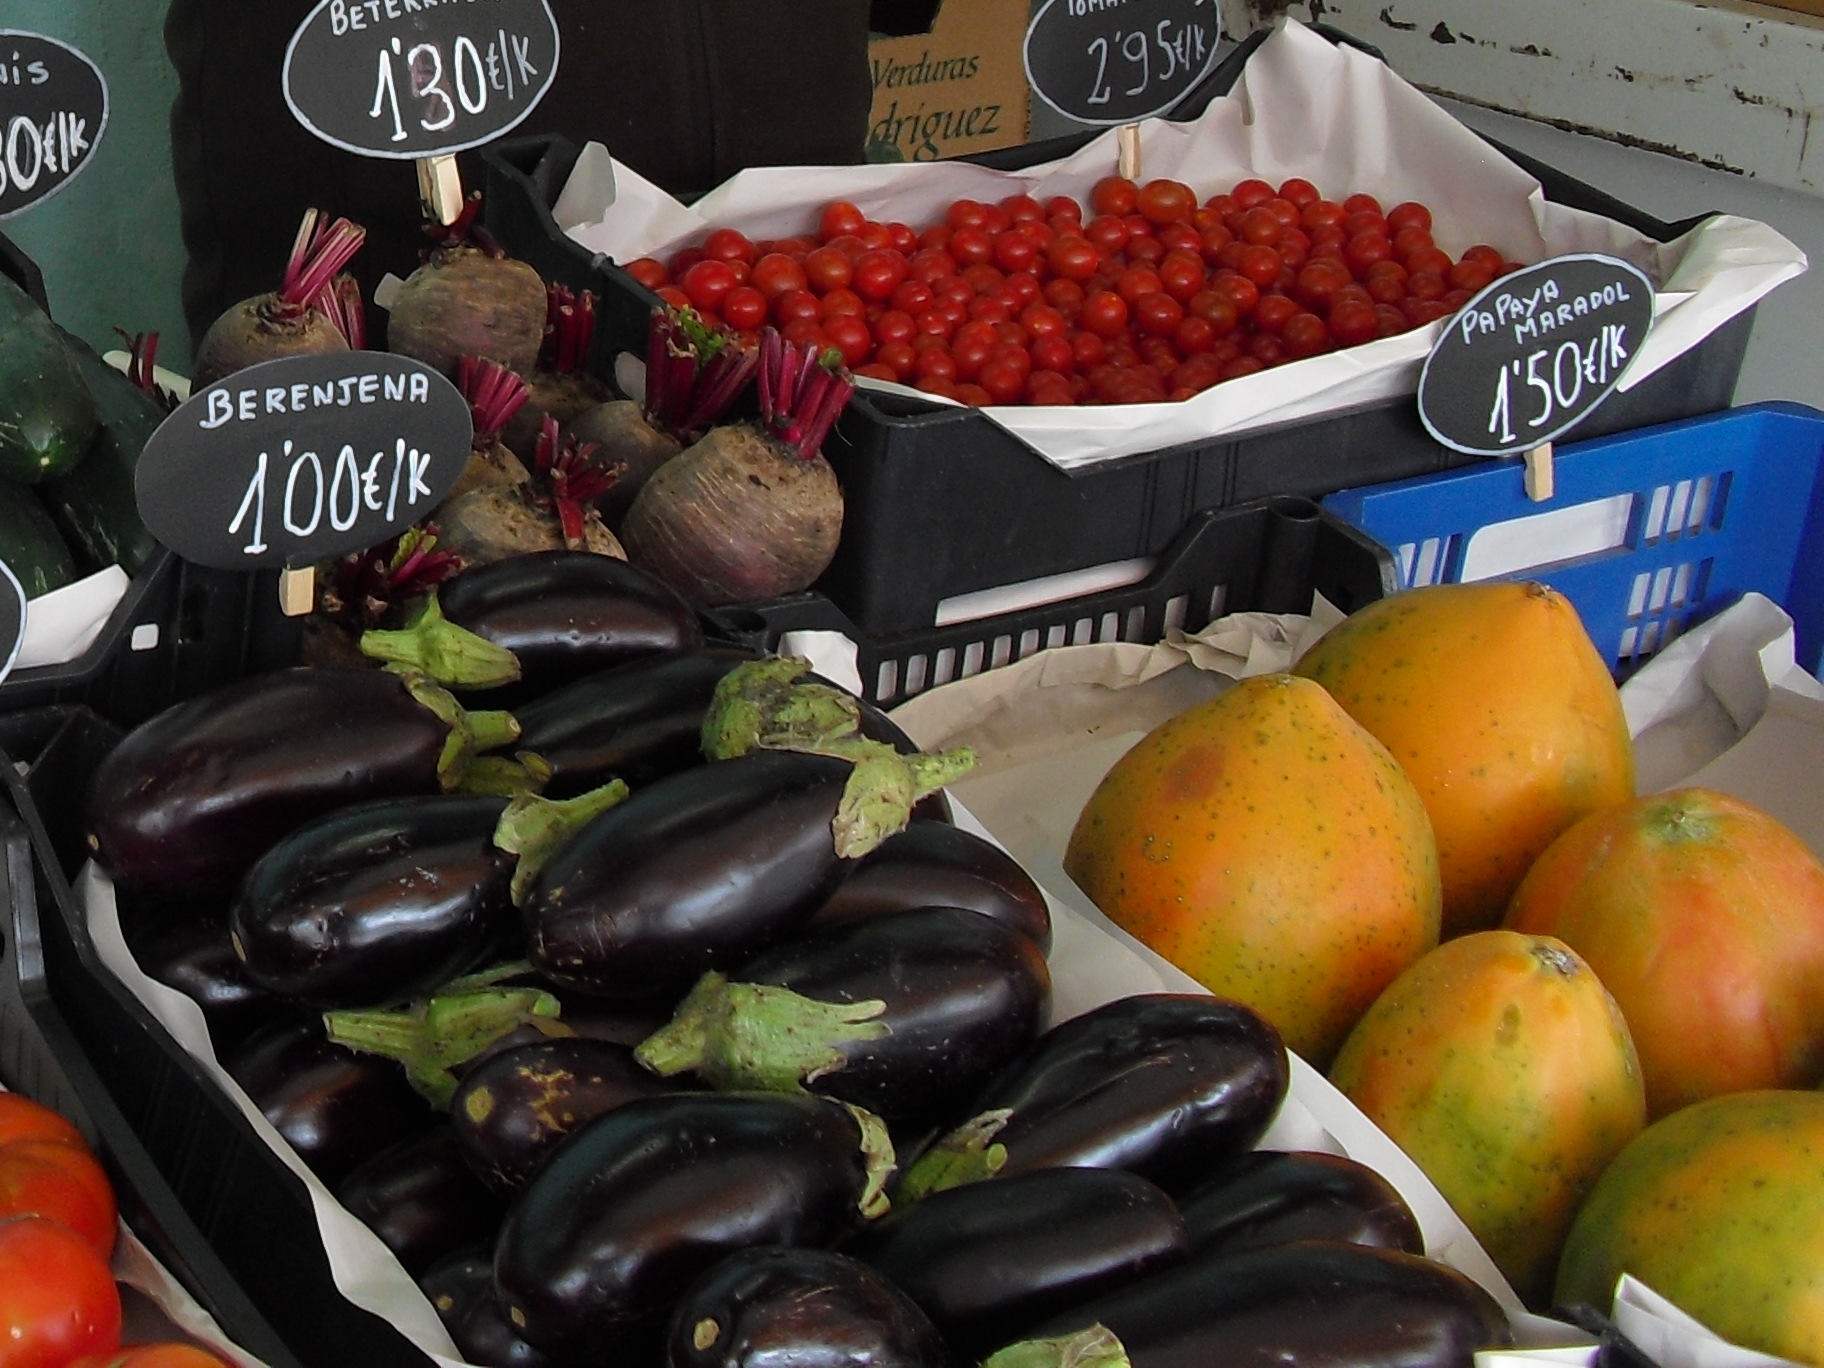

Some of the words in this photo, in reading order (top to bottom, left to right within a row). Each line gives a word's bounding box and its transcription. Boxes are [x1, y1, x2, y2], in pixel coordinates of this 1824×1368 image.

[873, 51, 979, 89] Verduras
[1461, 279, 1560, 345] PAPAYA
[1513, 281, 1631, 345] MARADOL
[198, 372, 430, 430] BERENJENA
